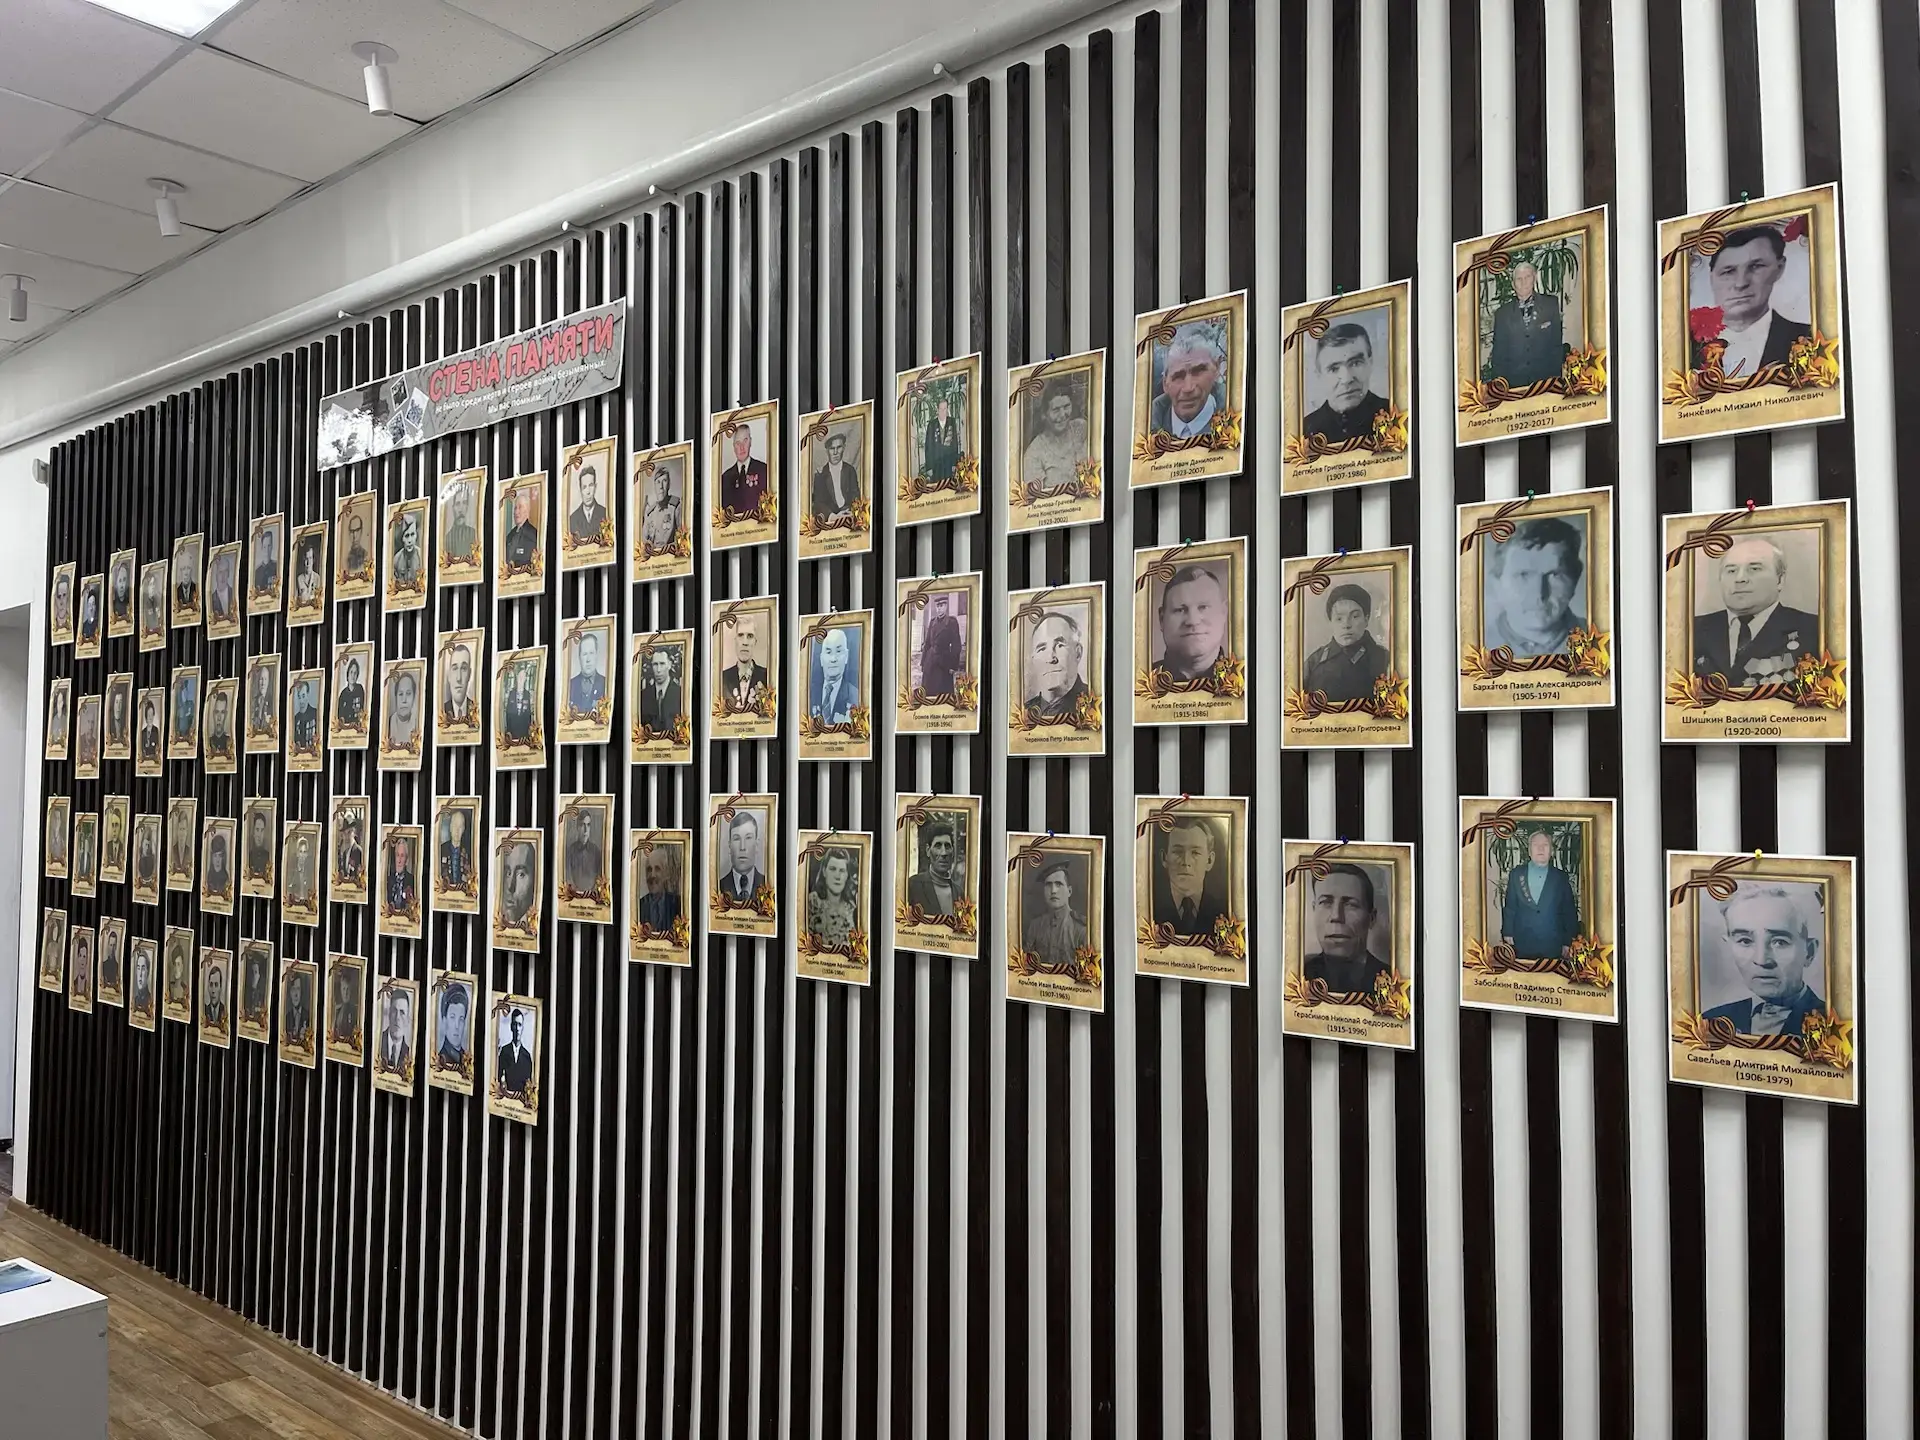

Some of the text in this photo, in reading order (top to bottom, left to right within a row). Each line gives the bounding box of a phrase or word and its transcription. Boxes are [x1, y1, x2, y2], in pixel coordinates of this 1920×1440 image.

[429, 314, 614, 403] СТЕНА ПАМЯТИ
[461, 396, 482, 409] среди
[1677, 392, 1824, 419] Зинкевич Михаил Николаевич
[1467, 400, 1597, 428] Лаврентьев Николай Елисеевич
[1506, 417, 1554, 433] (1922-2017)
[1173, 460, 1189, 468] Иван
[1324, 462, 1356, 473] Григорий
[1357, 454, 1404, 467] Афанасьевич
[1472, 679, 1602, 691] Бархатов Павел Александрович
[1512, 692, 1560, 701] (1905-1974)
[1172, 701, 1196, 709] Георгий
[1197, 700, 1232, 708] Андреевич
[1682, 714, 1827, 724] Шишкин Василий Семенович
[1324, 726, 1356, 734] Надежда
[1357, 725, 1401, 734] Григорьевна
[1724, 727, 1782, 738] (1920-2000)
[1170, 961, 1196, 969] Николай
[1197, 964, 1236, 973] Григорьевич
[1474, 978, 1607, 998] Забойкин Владимир Степанович
[1515, 993, 1562, 1006] (1924-2013)
[1293, 1011, 1403, 1029] Герасимов Николай Федорович
[1687, 1053, 1844, 1079] Савельев Дмитрий Михайлович
[1735, 1072, 1793, 1087] (1906-1979)
